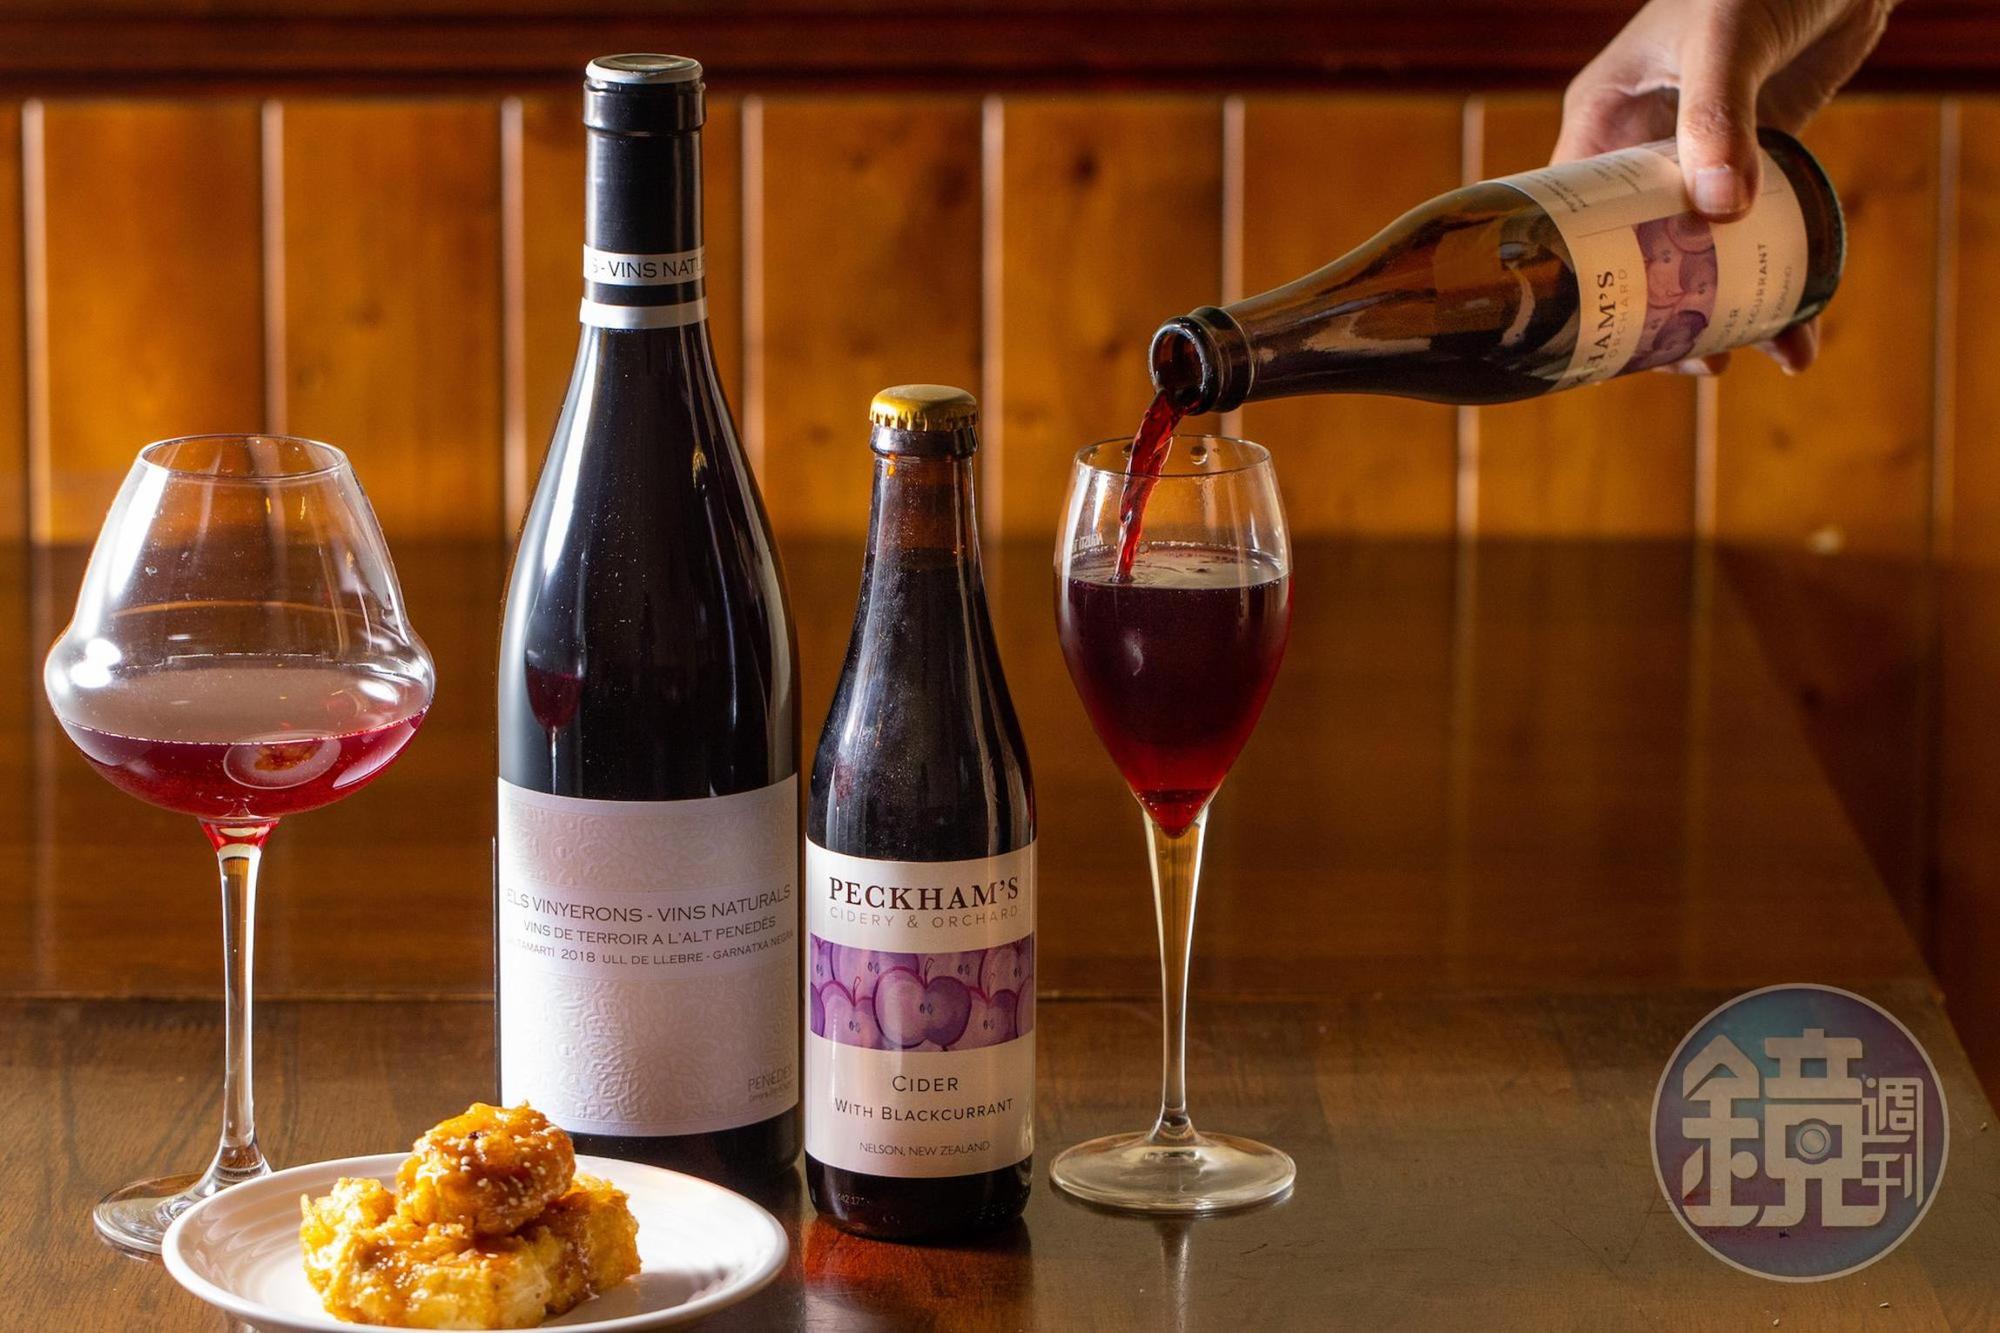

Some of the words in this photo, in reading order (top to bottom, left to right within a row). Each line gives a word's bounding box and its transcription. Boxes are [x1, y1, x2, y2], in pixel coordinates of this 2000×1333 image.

[607, 260, 657, 278] VINS
[532, 896, 643, 922] VINYERONS
[657, 905, 706, 922] VINS
[712, 884, 791, 918] NATURALS
[829, 877, 1018, 910] PECKHAM'S
[830, 906, 895, 927] CIDERY
[907, 915, 918, 928] &
[932, 905, 1018, 928] ORCHARD
[523, 919, 551, 937] VINS
[554, 926, 573, 941] DE
[577, 930, 648, 945] TERROIR
[652, 934, 664, 945] A
[561, 949, 596, 963] 2018
[602, 955, 628, 965] ULL
[631, 956, 649, 965] DE
[653, 953, 704, 965] LLEBRE
[713, 939, 768, 960] GARNATXA
[835, 1098, 873, 1118] WITH
[881, 1098, 1013, 1122] BLACKCURRANT
[859, 1141, 906, 1157] NELSON,
[908, 1147, 937, 1156] NEW
[940, 1141, 990, 1155] ZEALAND
